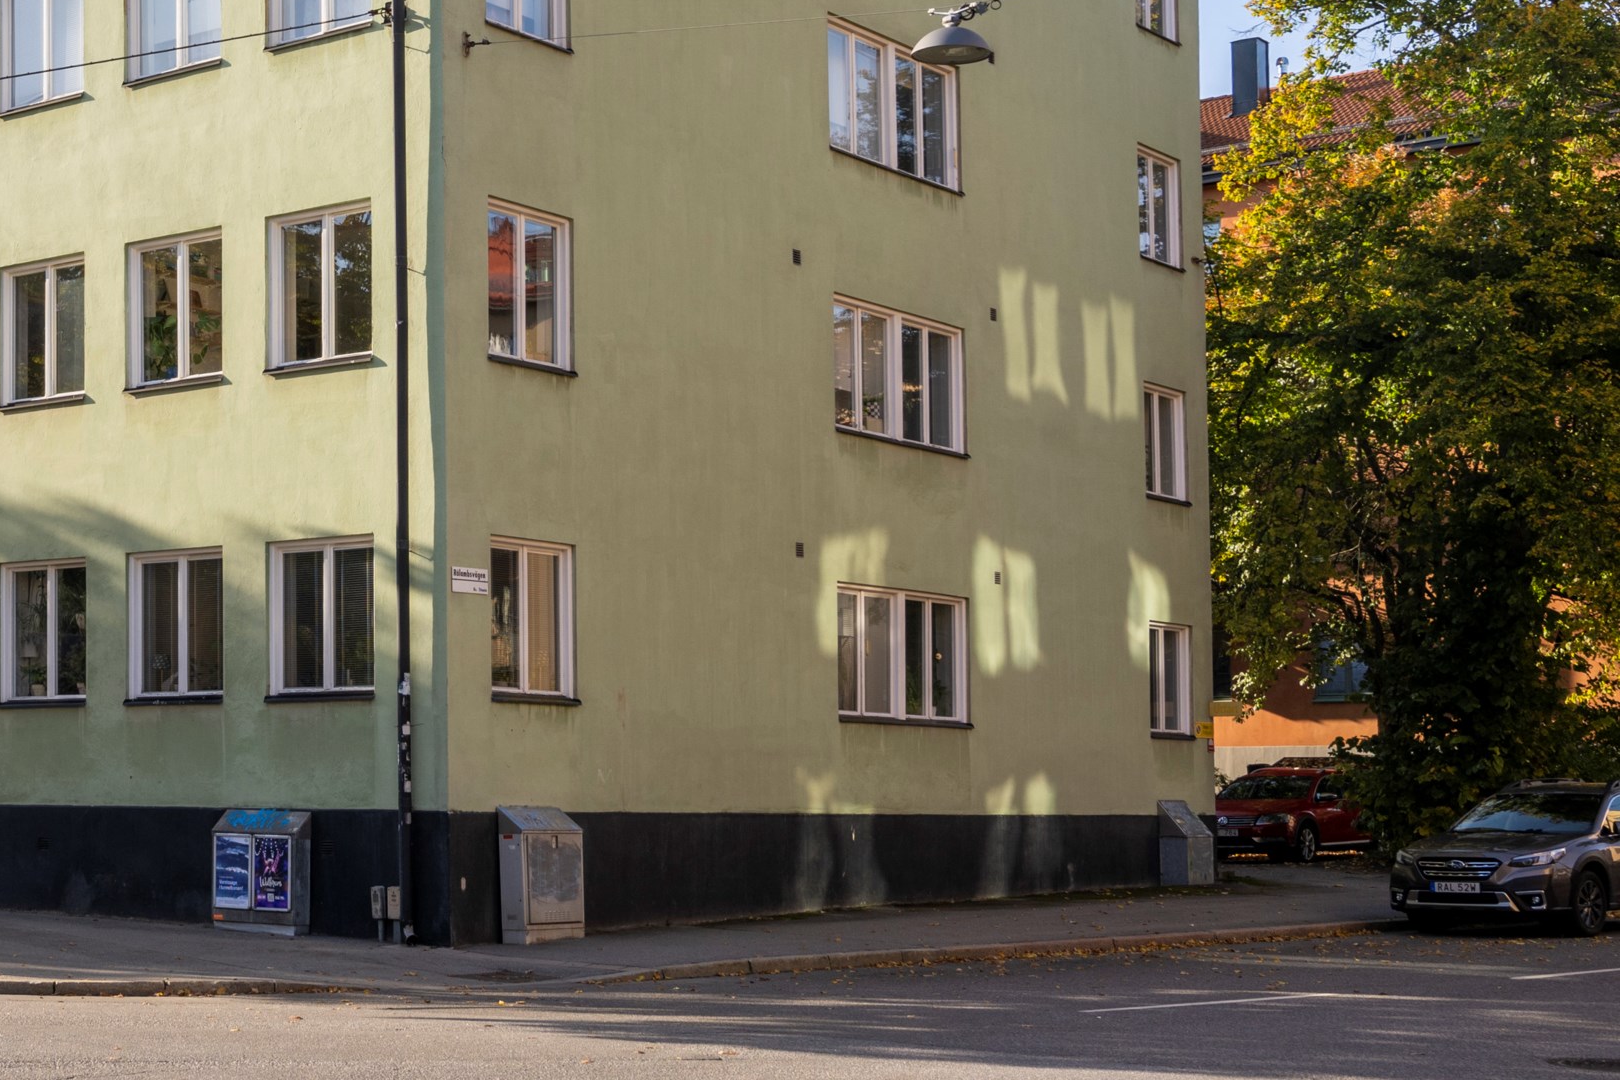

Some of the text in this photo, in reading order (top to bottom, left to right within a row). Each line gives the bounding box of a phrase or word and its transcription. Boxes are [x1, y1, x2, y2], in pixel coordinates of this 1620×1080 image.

[454, 569, 485, 580] Rålambsvägen
[1438, 883, 1476, 892] RAL 52W
